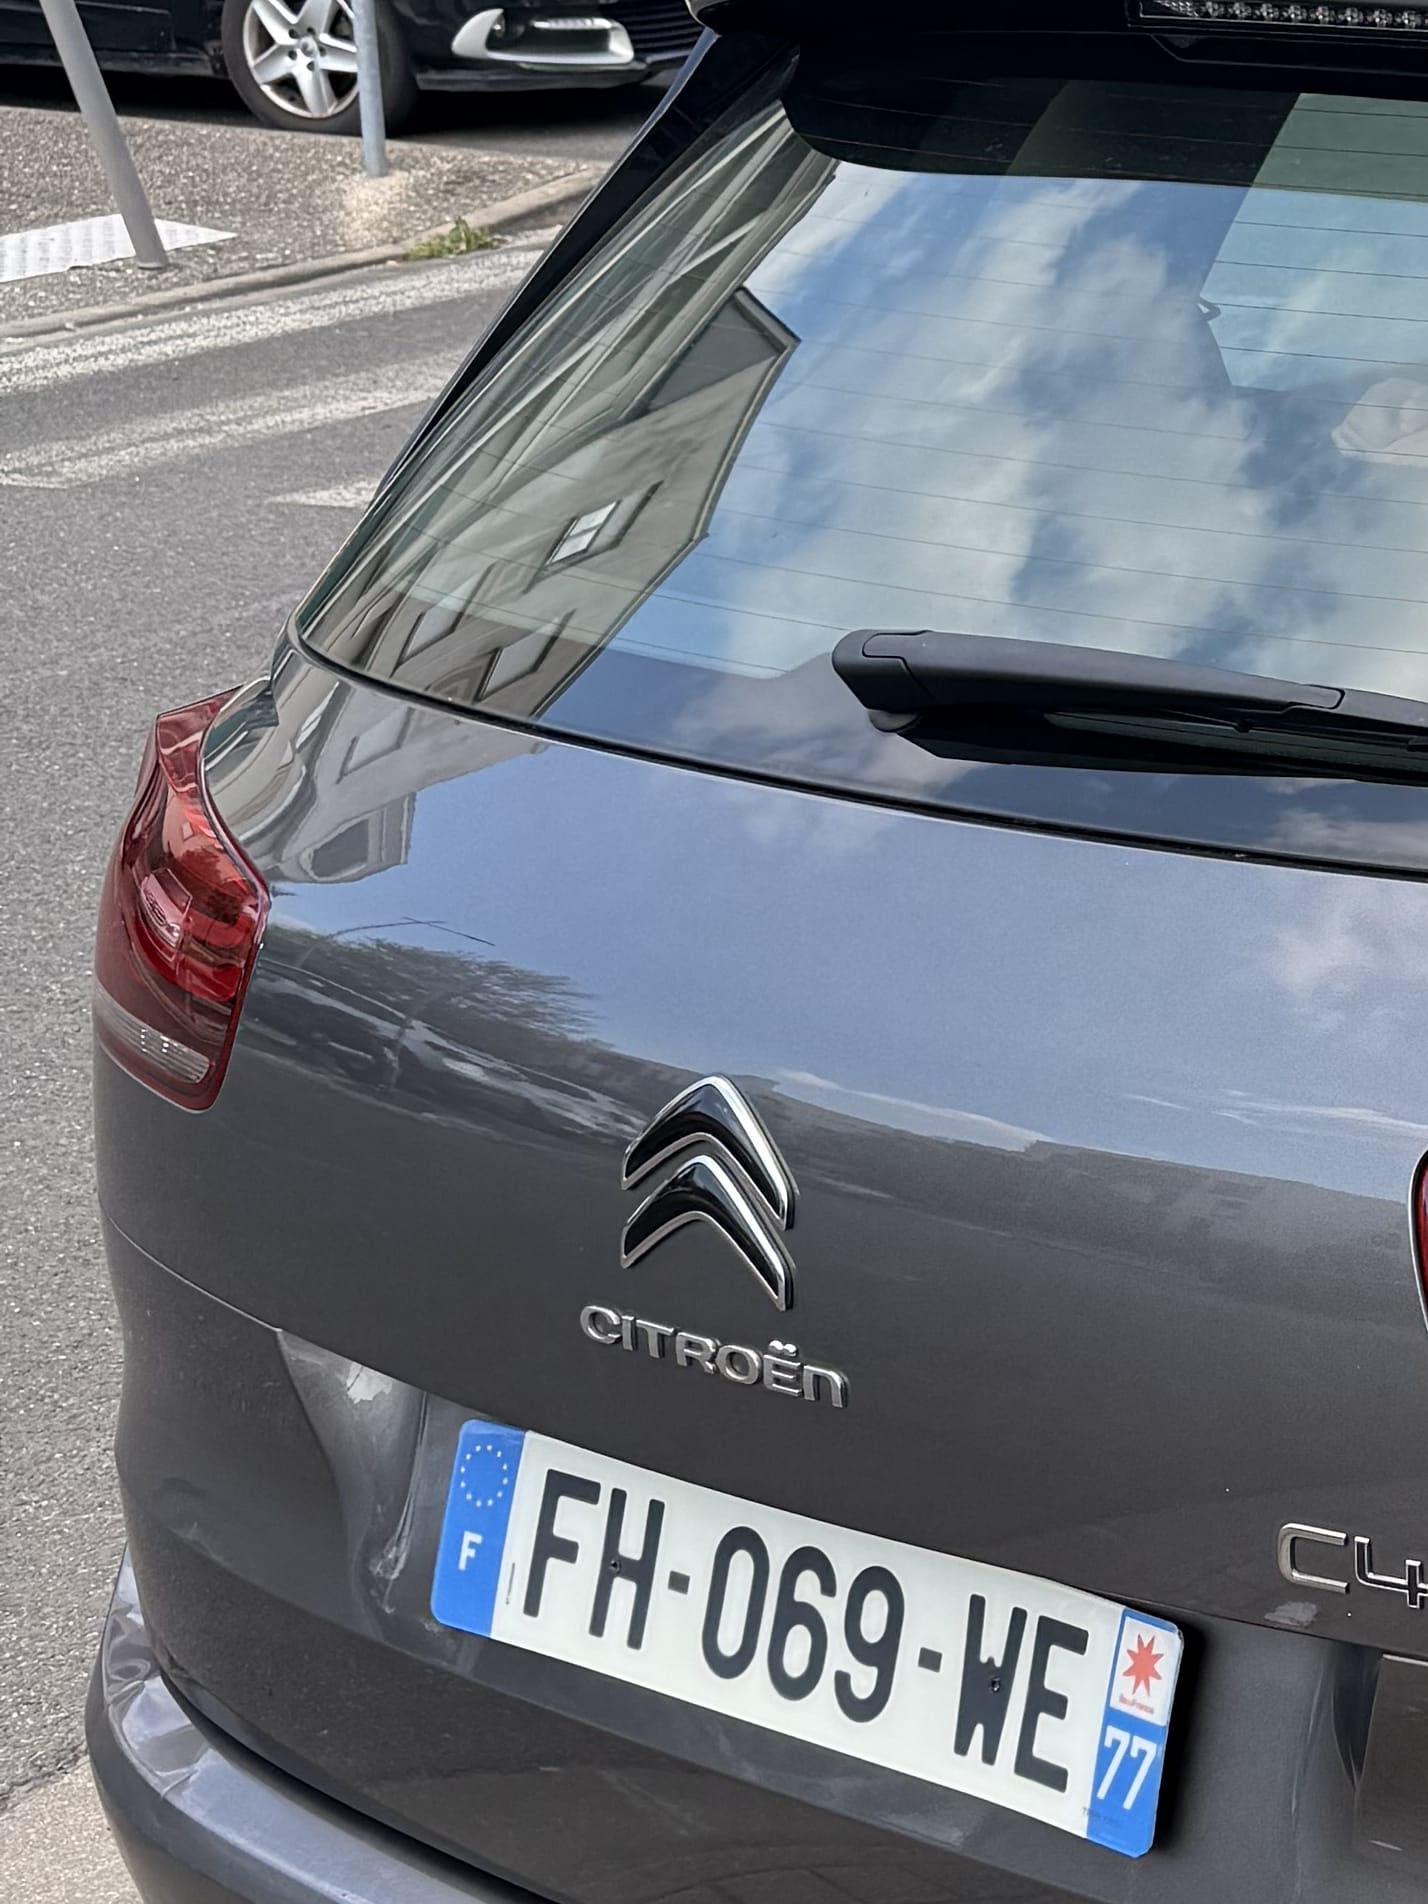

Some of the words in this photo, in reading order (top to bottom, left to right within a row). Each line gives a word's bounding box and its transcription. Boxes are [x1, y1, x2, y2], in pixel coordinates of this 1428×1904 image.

[458, 1531, 483, 1571] F
[523, 1469, 1089, 1793] FH-069-WE
[1096, 1725, 1157, 1810] 77
